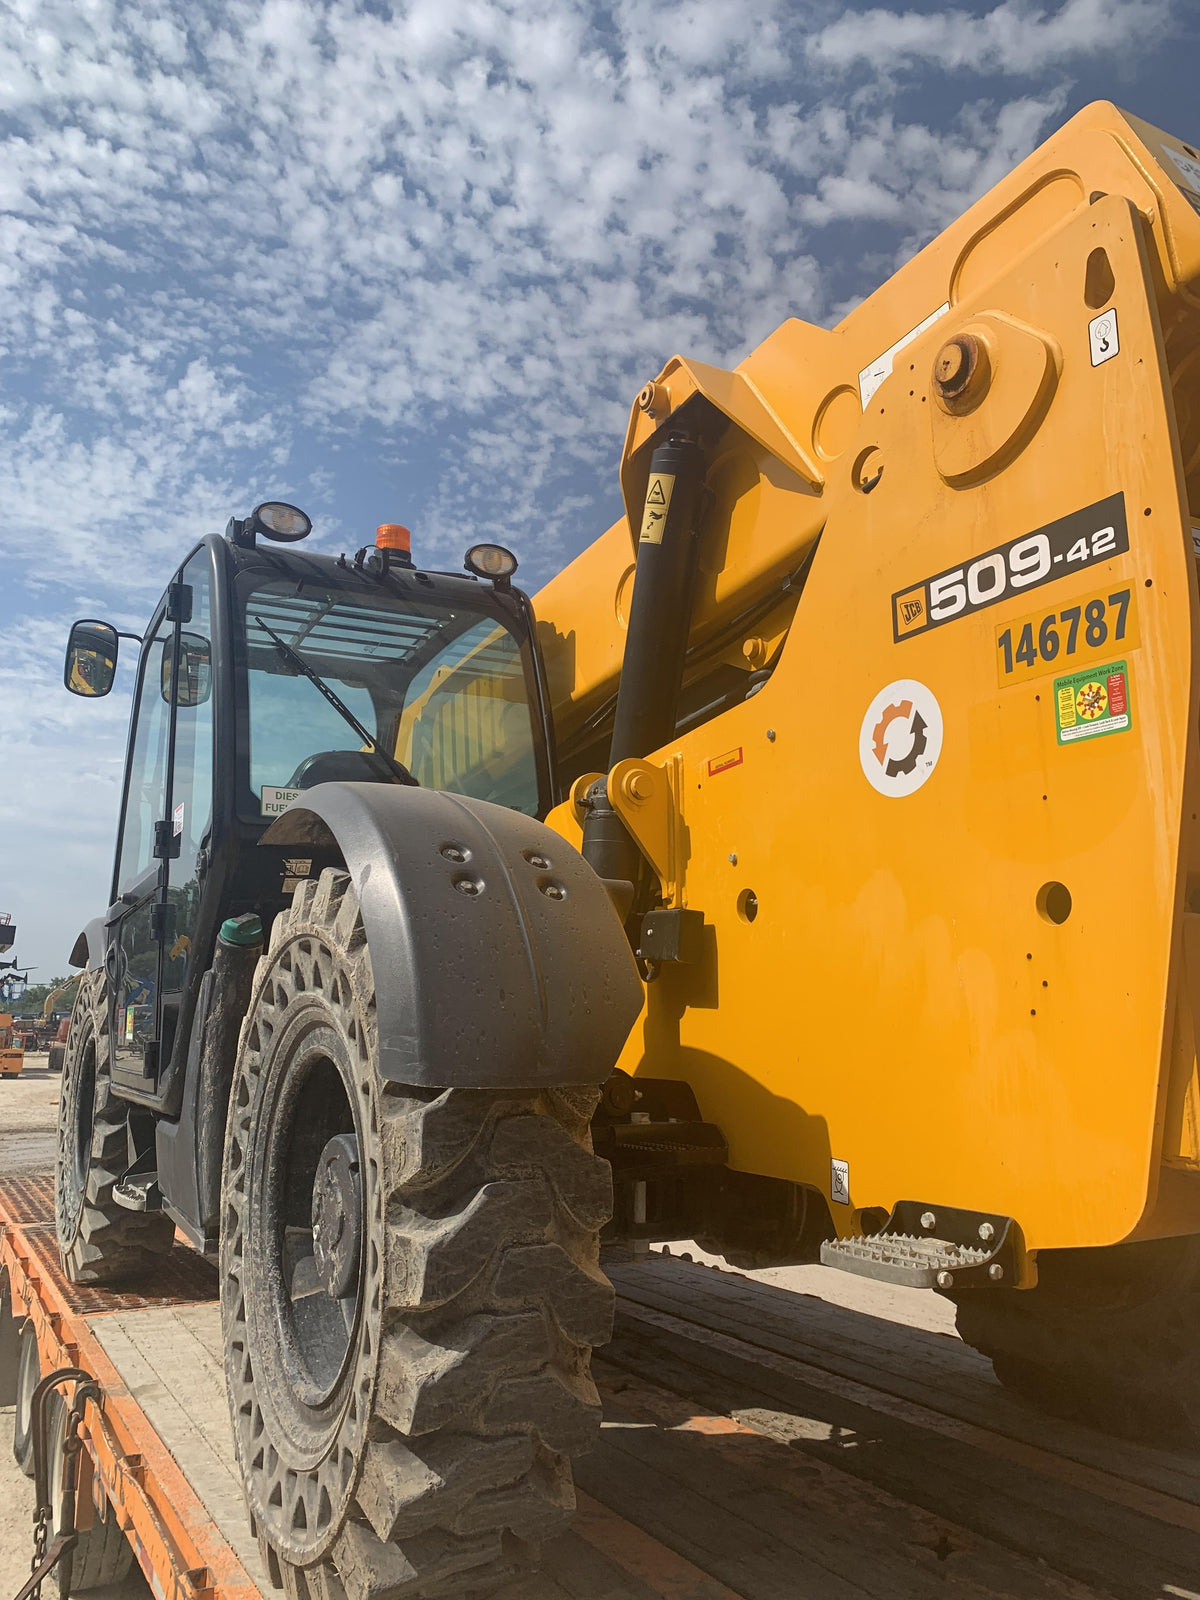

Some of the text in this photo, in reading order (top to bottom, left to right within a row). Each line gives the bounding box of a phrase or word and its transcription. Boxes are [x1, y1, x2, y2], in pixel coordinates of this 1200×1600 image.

[930, 527, 1116, 621] 509-42
[903, 601, 922, 622] JCB
[998, 589, 1131, 674] 146787
[1057, 665, 1124, 687] Mobile Equipment Work Zone
[275, 792, 299, 801] DIES
[265, 803, 288, 812] FUE
